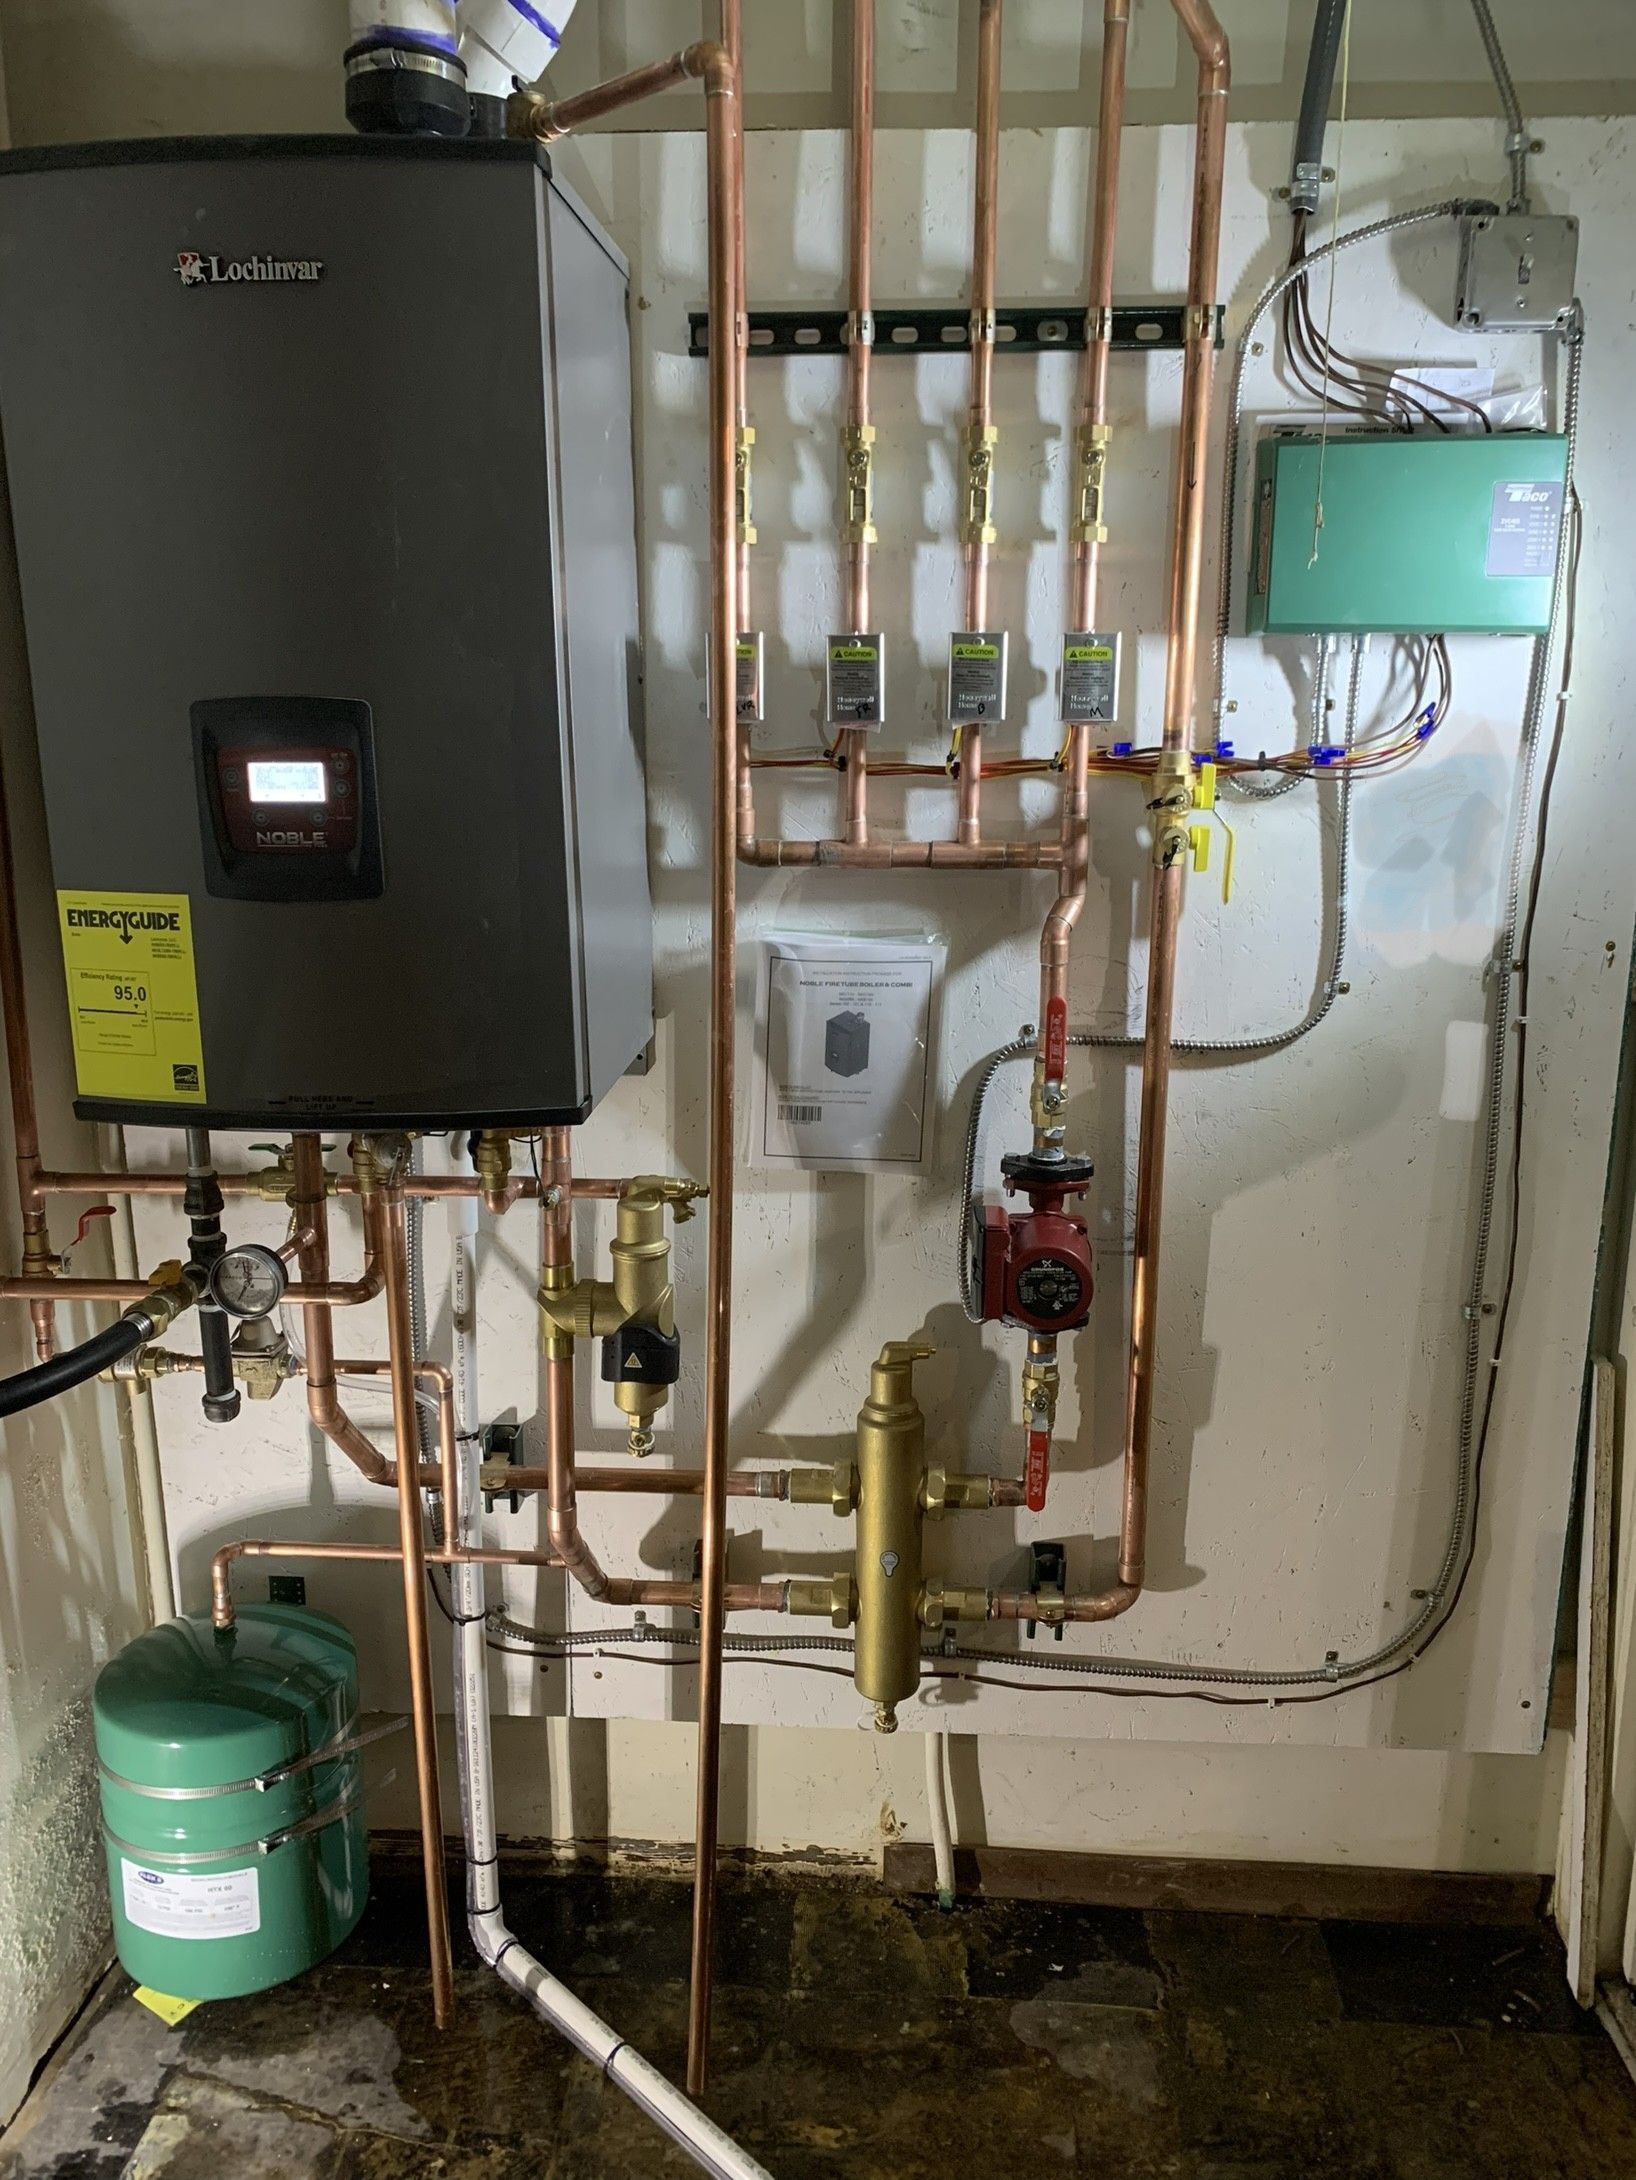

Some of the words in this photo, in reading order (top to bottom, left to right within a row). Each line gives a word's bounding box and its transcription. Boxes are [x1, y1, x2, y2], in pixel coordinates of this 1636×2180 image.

[208, 255, 323, 282] Lochinvar
[1345, 424, 1390, 434] Instruction
[1504, 483, 1549, 502] Taco
[1090, 707, 1104, 718] M
[256, 831, 325, 845] NOBLE
[80, 972, 105, 981] Efficiency
[106, 974, 123, 982] Rating
[114, 985, 147, 1001] 95.0
[455, 1257, 463, 1266] IN
